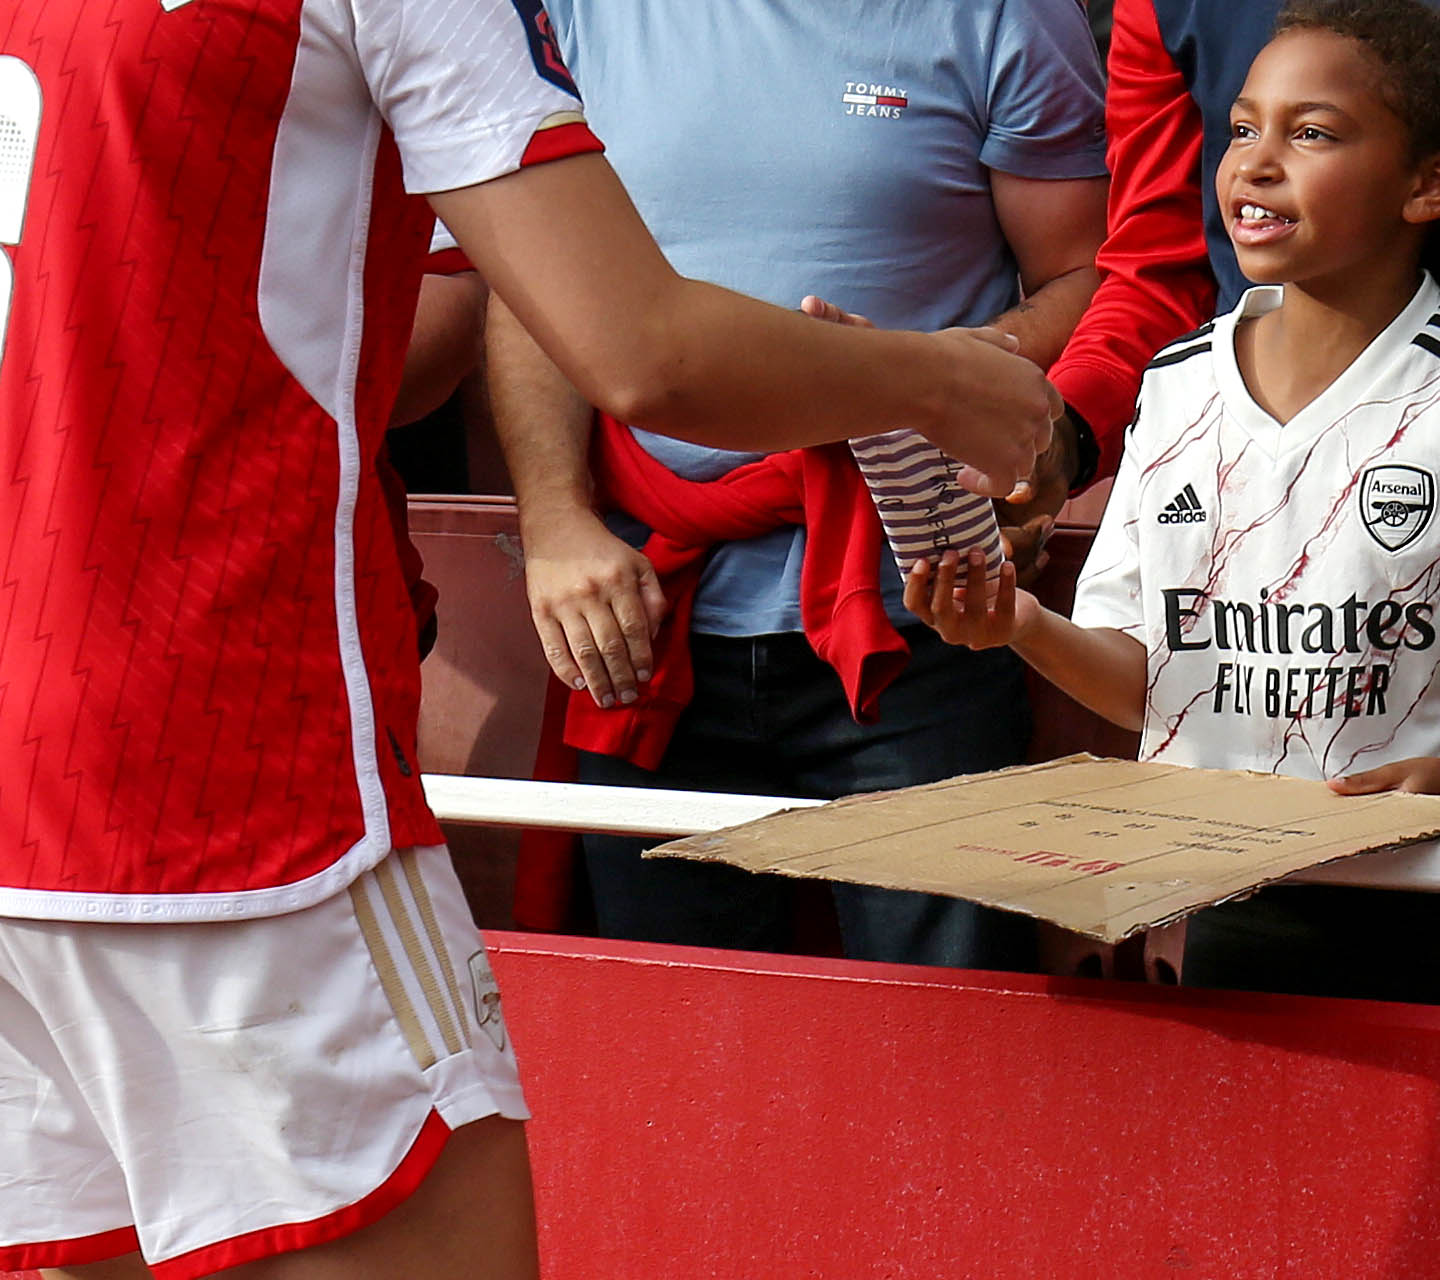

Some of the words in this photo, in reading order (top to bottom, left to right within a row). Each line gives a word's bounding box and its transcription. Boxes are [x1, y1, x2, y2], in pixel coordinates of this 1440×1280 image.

[844, 81, 908, 99] TOMMY
[846, 105, 902, 120] JEANS
[1371, 478, 1422, 498] Arsenal
[1156, 509, 1208, 526] adidas
[1159, 586, 1437, 655] Emirates
[1212, 662, 1255, 716] FLY
[1264, 663, 1390, 720] BETTER
